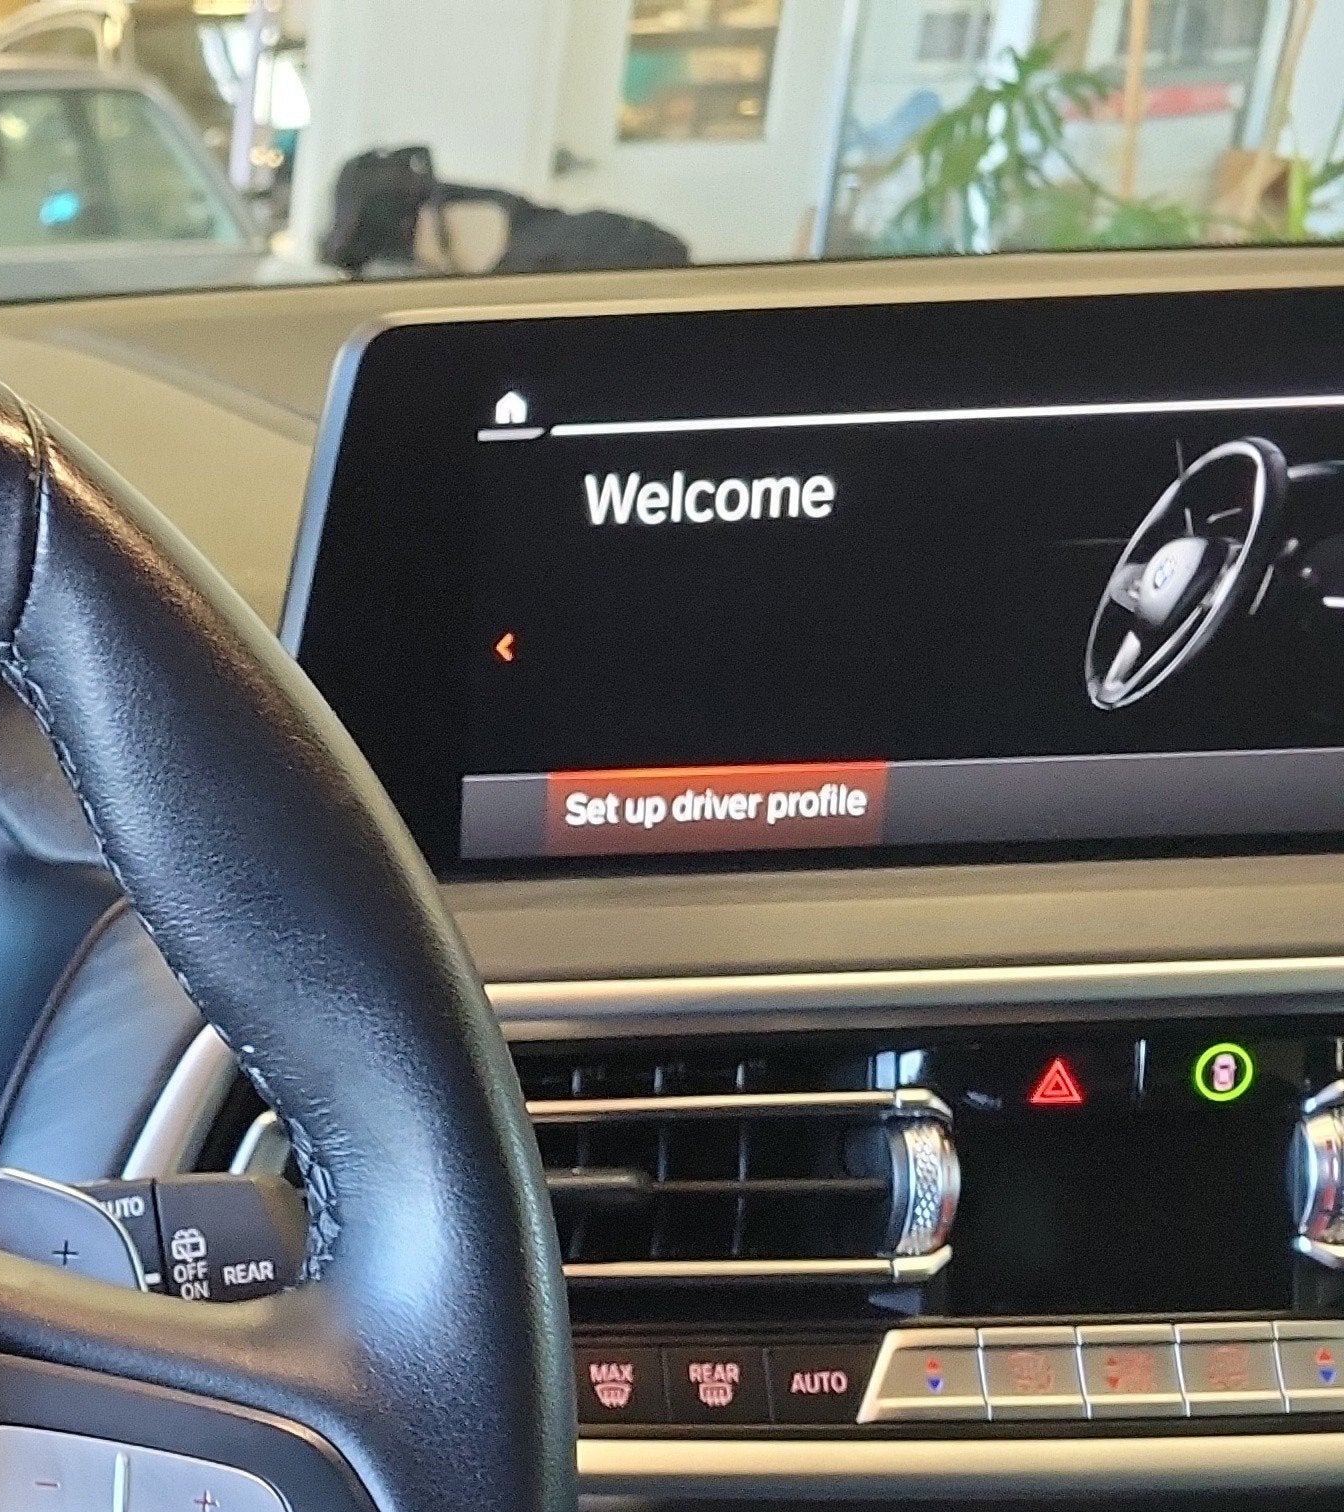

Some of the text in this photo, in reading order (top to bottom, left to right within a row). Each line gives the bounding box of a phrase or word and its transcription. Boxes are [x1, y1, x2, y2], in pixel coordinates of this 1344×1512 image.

[584, 471, 837, 526] Welcome
[565, 784, 868, 829] Set up driver profile
[173, 1261, 208, 1283] OFF
[223, 1260, 274, 1286] REAR
[180, 1281, 210, 1301] ON
[590, 1363, 634, 1383] MAX
[689, 1362, 740, 1383] REAR
[790, 1370, 848, 1395] AUTO
